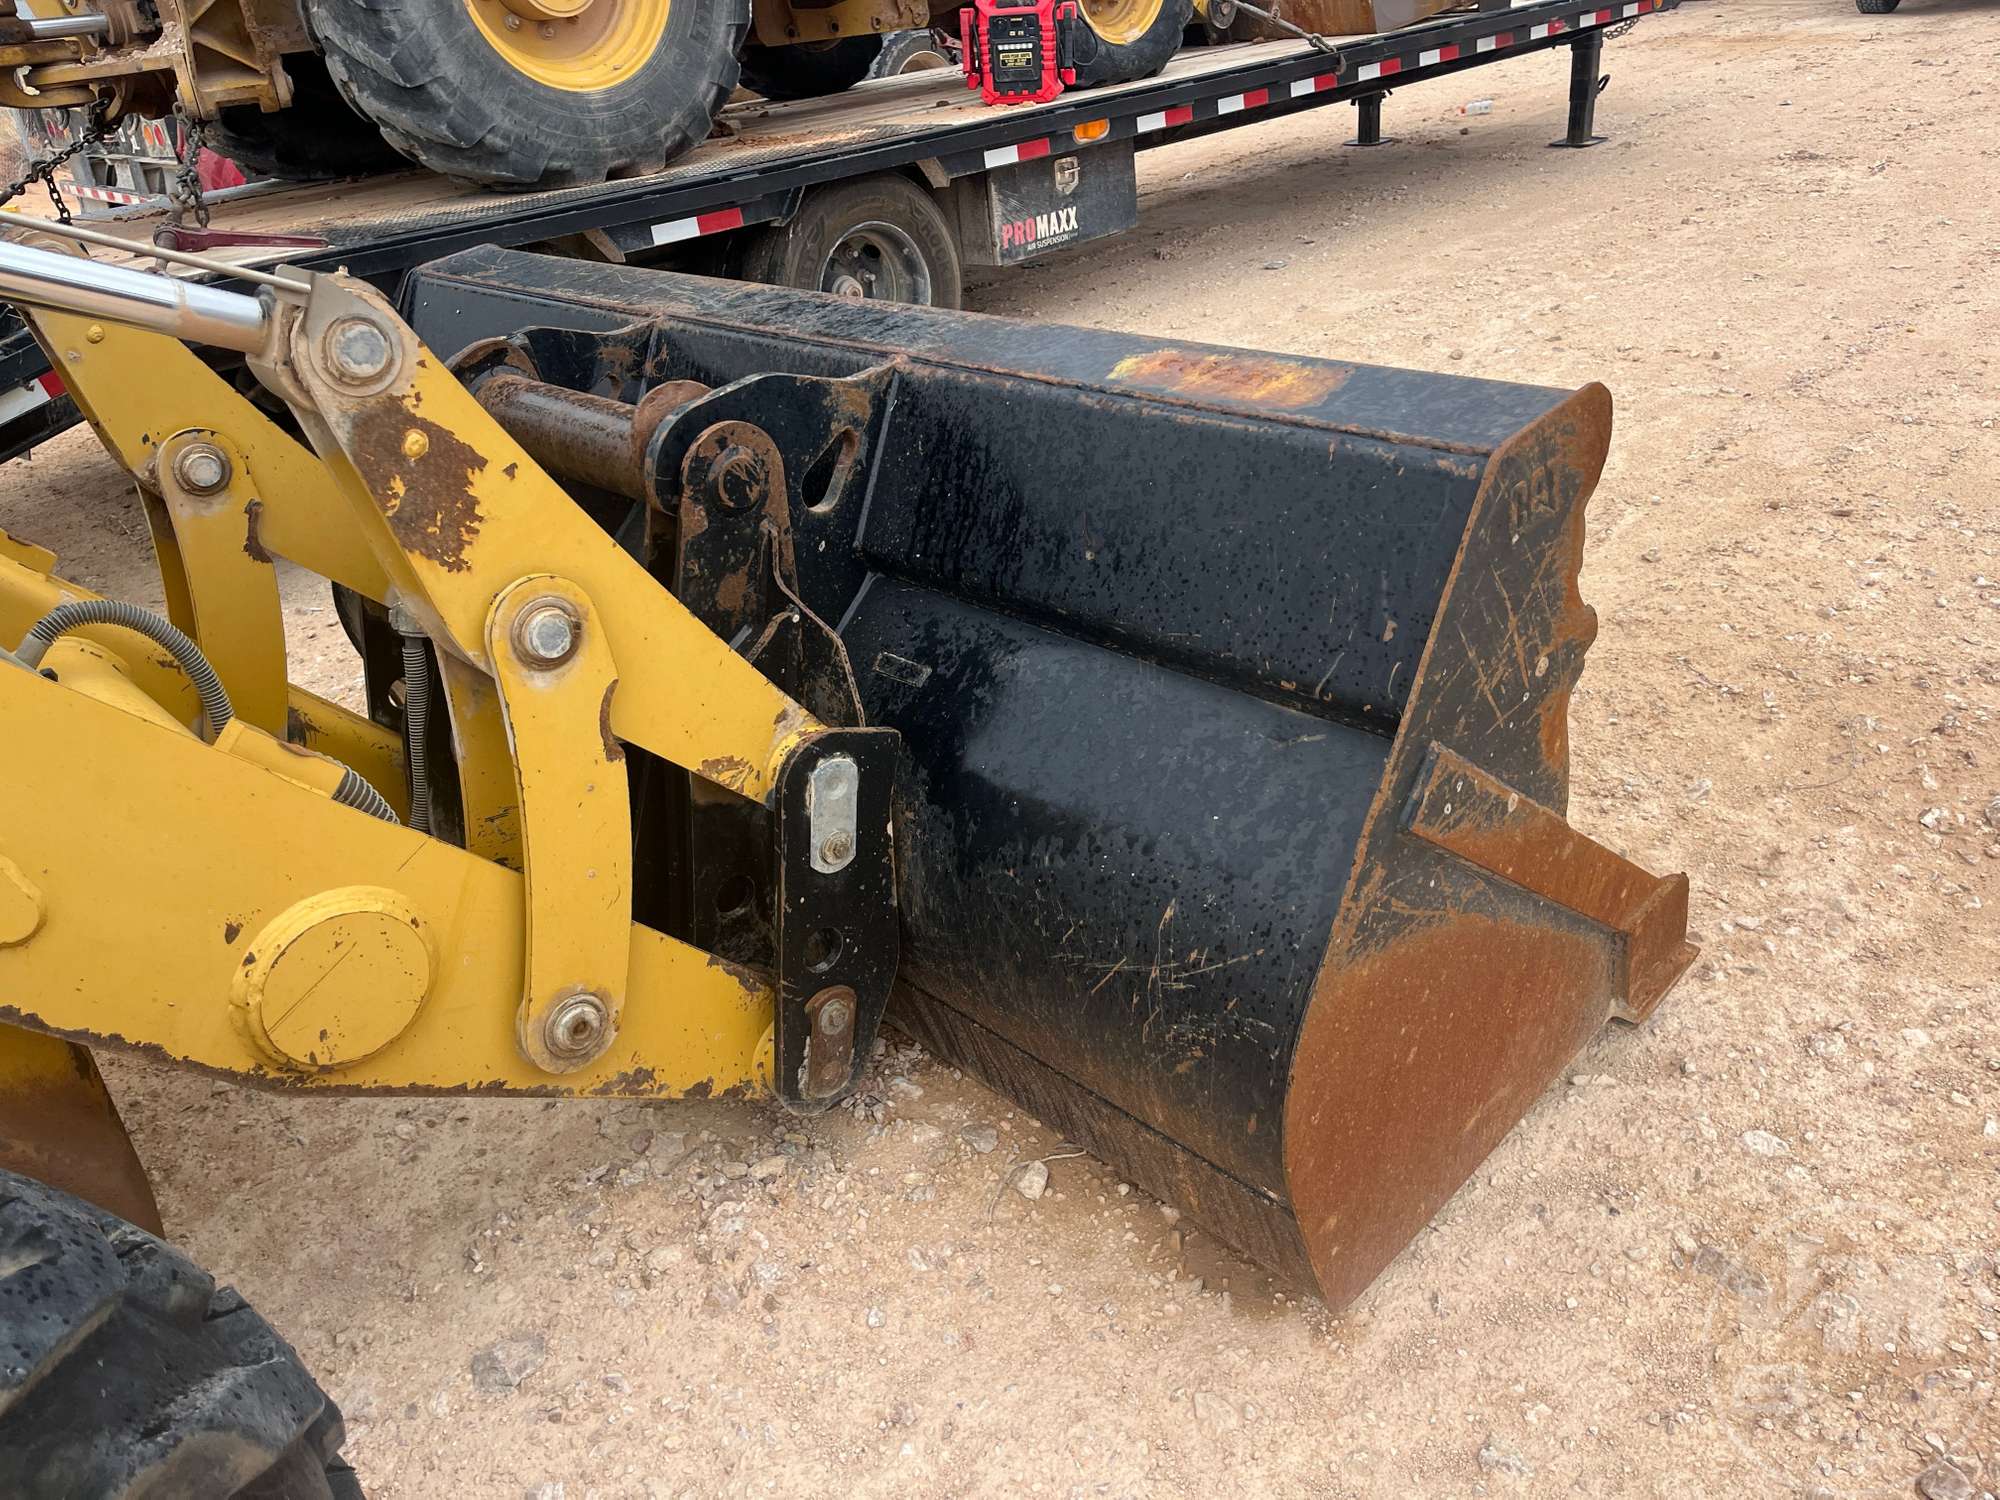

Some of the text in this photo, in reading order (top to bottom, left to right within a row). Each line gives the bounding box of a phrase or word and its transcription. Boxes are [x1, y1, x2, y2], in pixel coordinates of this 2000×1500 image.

[1002, 206, 1078, 249] PROMAXX
[1027, 243, 1036, 251] AIR
[1037, 233, 1069, 248] SUSPENSION
